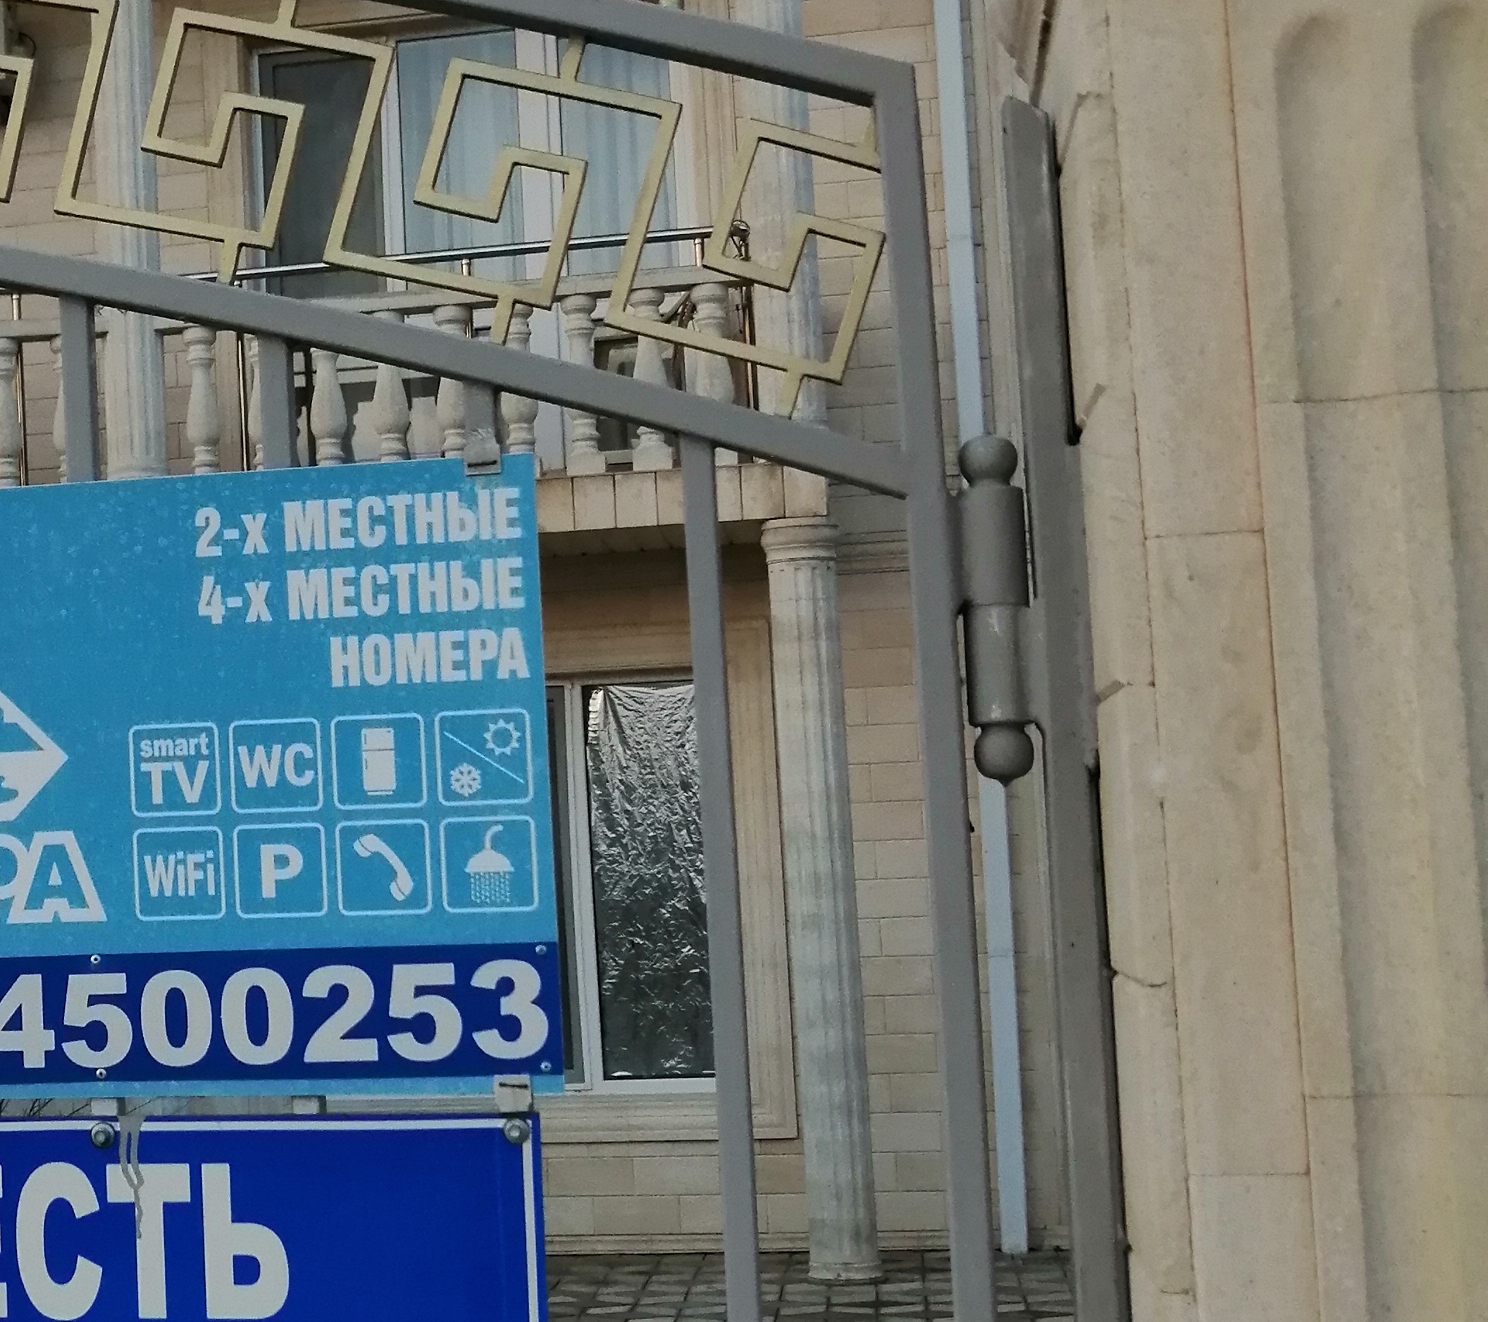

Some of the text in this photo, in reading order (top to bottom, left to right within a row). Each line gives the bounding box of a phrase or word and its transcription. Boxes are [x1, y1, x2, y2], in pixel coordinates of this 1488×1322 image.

[283, 487, 521, 552] МЕСТНЫЕ
[286, 557, 525, 620] МЕСТНЫЕ
[330, 628, 530, 688] НОМЕРА
[140, 733, 209, 757] smart
[238, 743, 314, 789] WC
[141, 760, 210, 805] TV
[144, 850, 215, 898] WiFi
